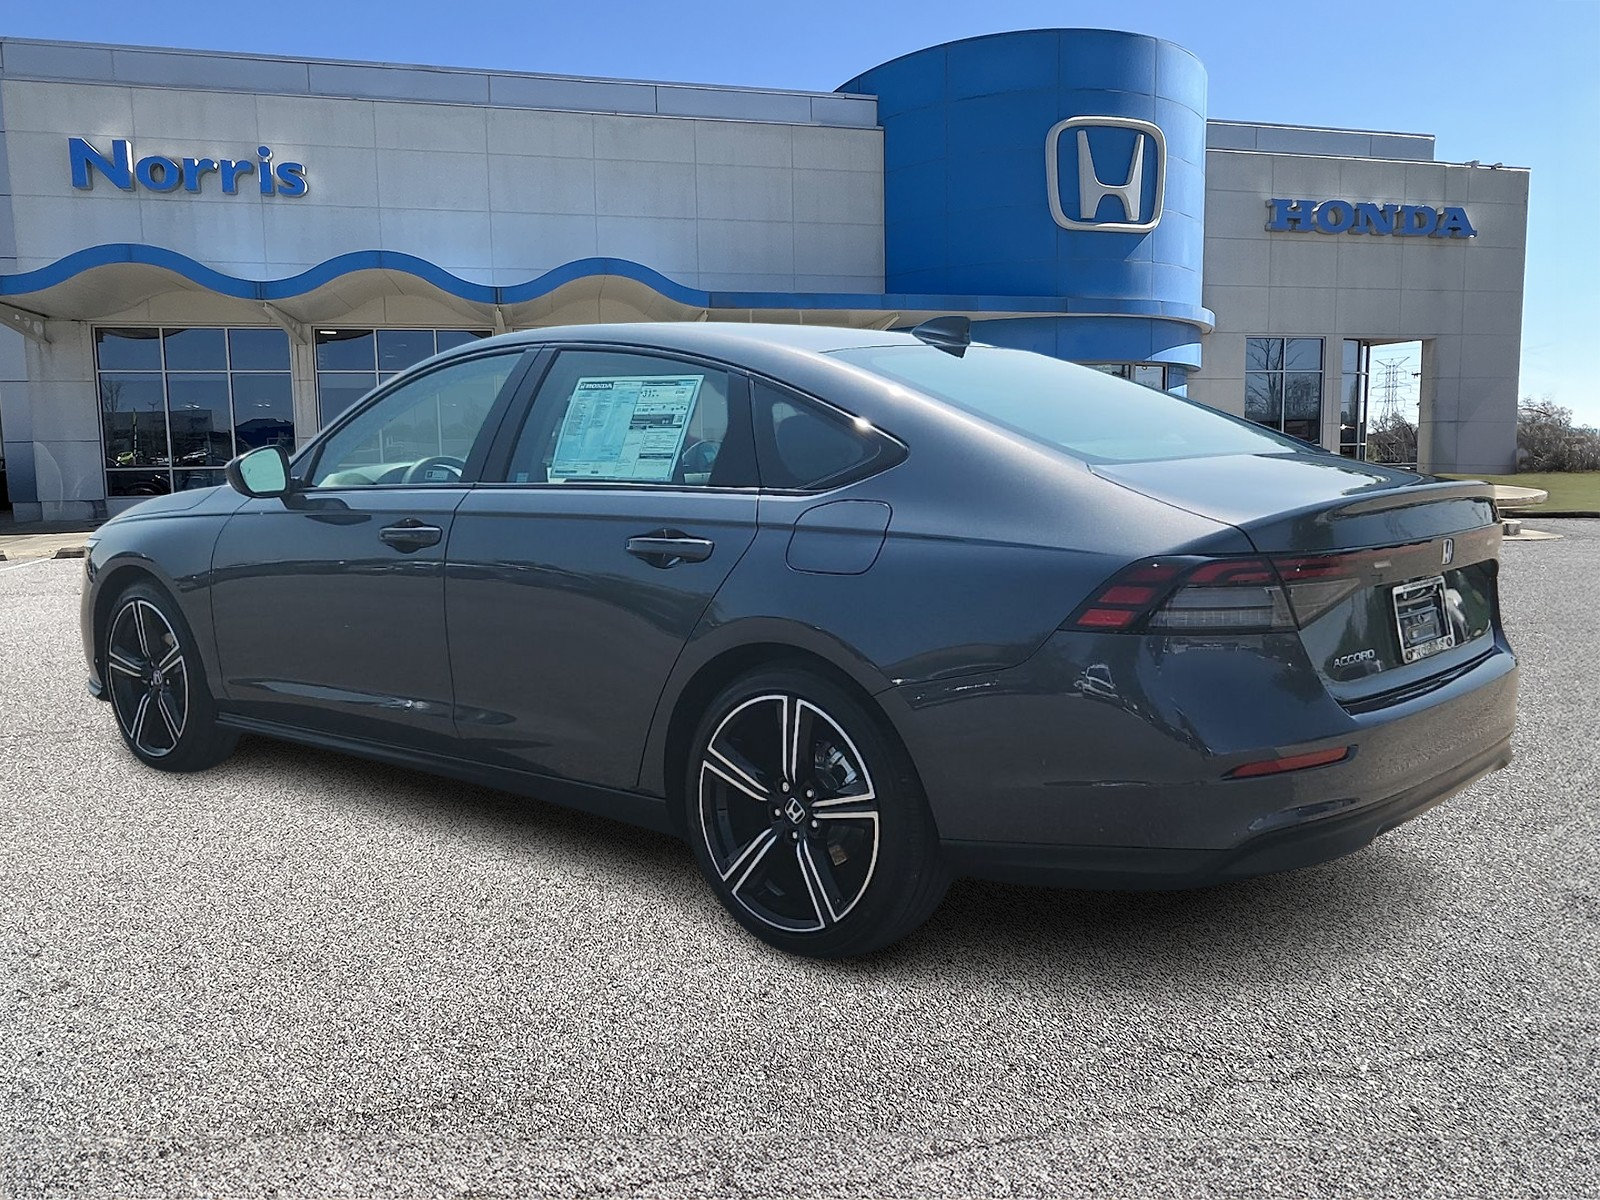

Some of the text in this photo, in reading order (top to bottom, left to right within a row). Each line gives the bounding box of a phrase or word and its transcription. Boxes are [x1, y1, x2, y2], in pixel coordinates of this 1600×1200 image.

[68, 138, 309, 197] Norris
[1266, 198, 1477, 238] HONDA
[1333, 649, 1375, 669] ACCORD
